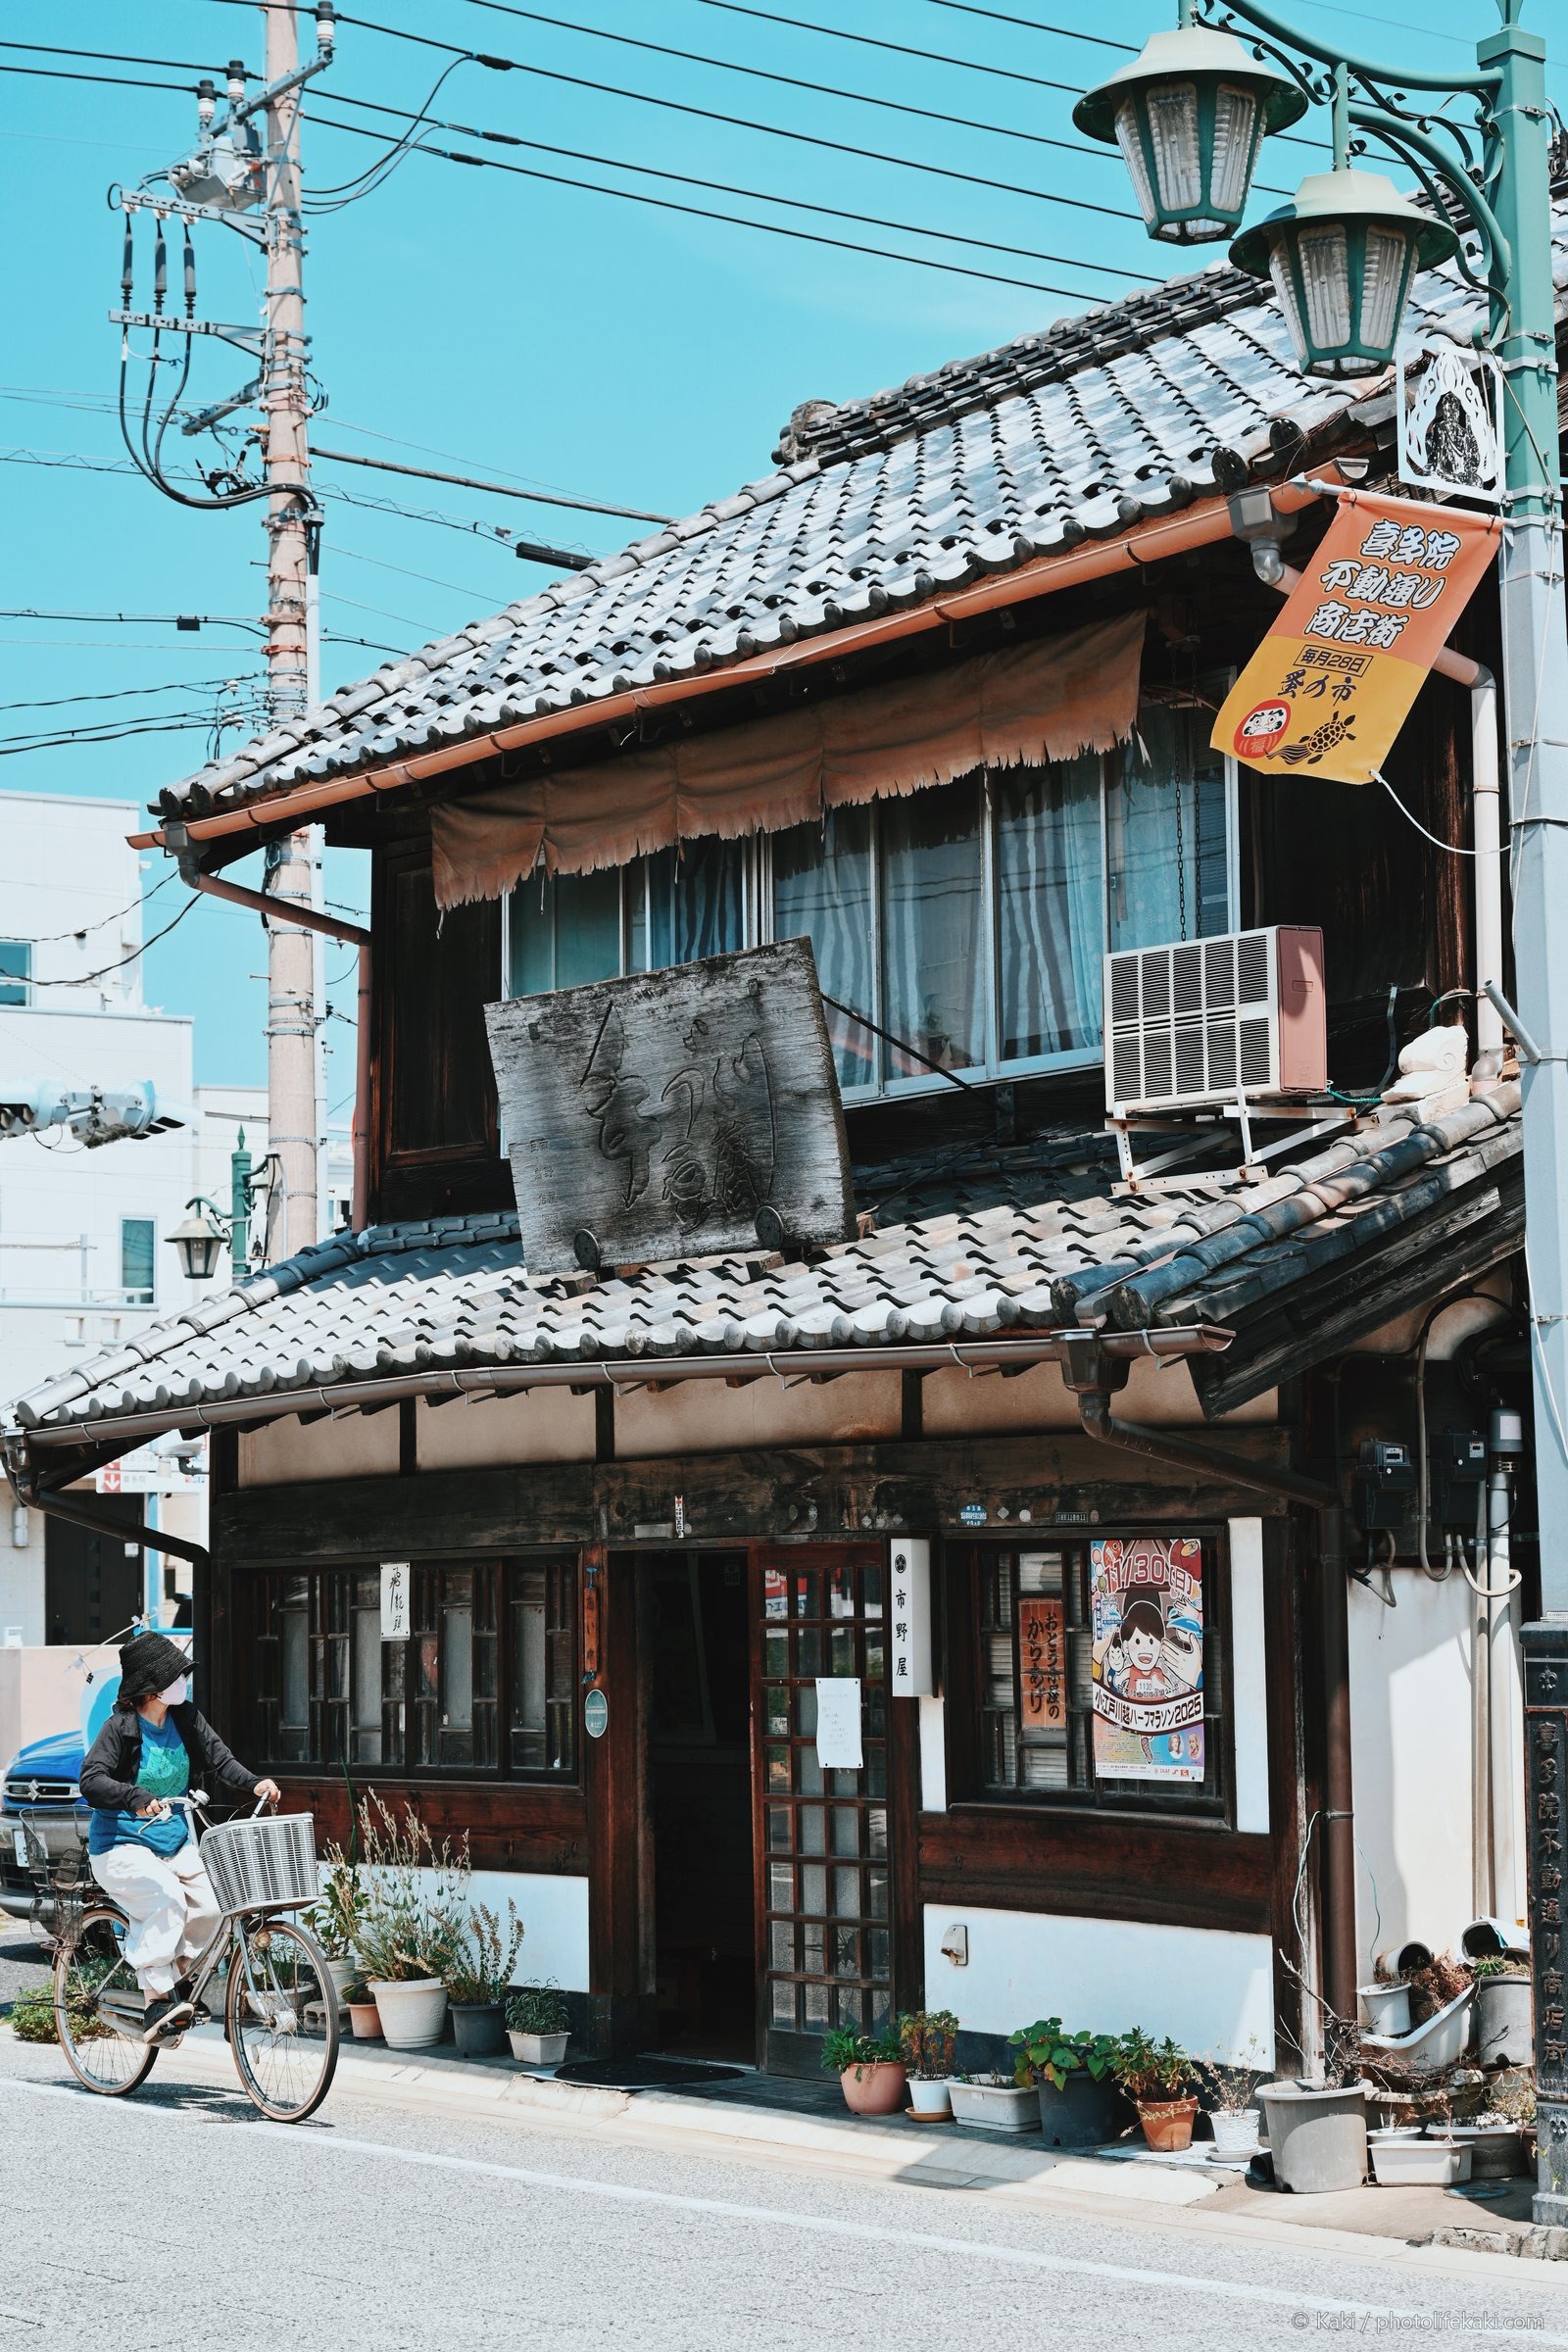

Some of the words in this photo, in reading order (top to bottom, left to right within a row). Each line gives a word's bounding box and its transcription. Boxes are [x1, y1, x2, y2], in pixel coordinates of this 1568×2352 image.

[1360, 518, 1461, 570] 喜多院
[1319, 560, 1446, 609] 不動通り
[1304, 601, 1409, 649] 商店街
[1300, 649, 1366, 673] 毎月28日
[1250, 738, 1265, 754] 福
[895, 1589, 908, 1677] 市野屋
[1095, 1689, 1202, 1729] 小江戸川越ハーフマラソン2025
